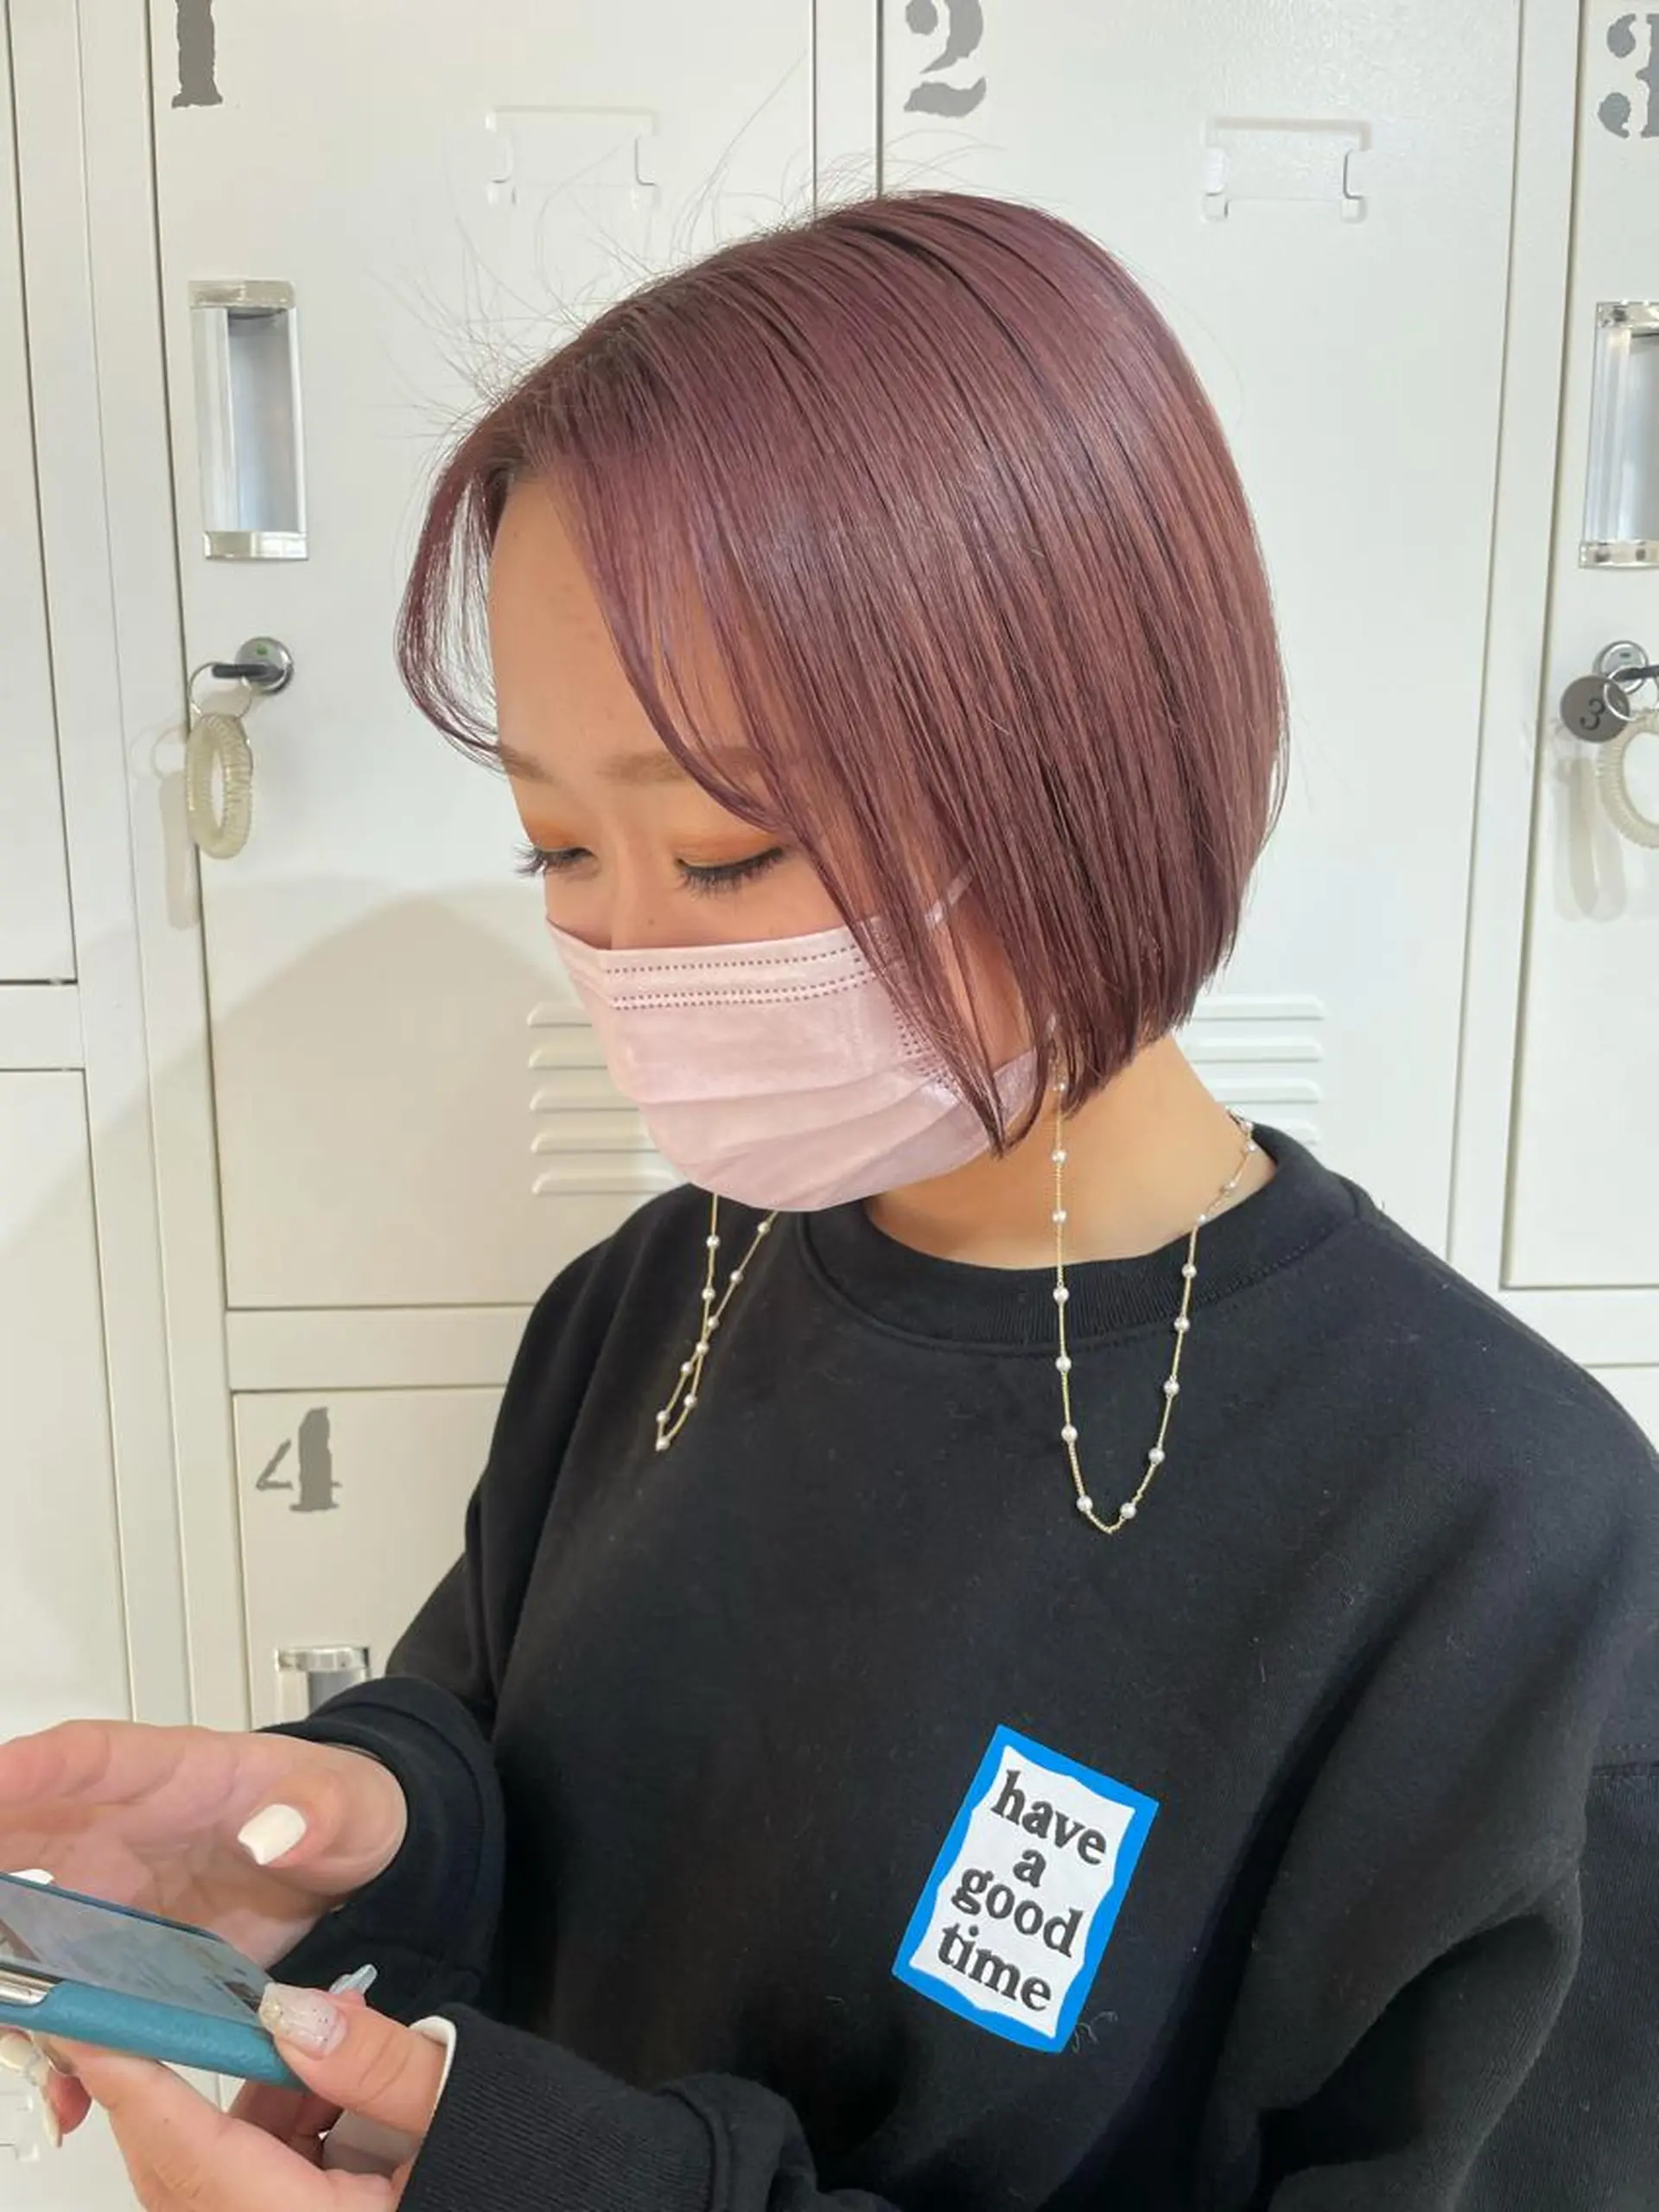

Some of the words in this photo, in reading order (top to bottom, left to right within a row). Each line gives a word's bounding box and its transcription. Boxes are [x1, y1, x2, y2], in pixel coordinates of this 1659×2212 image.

[171, 0, 223, 109] 1
[903, 0, 987, 118] 2
[1598, 13, 1659, 139] 3
[1579, 697, 1606, 731] 3
[256, 1407, 343, 1512] 4
[990, 1769, 1107, 1866] have
[950, 1868, 1084, 1959] good
[1012, 1848, 1047, 1888] a
[937, 1923, 1052, 2012] time
